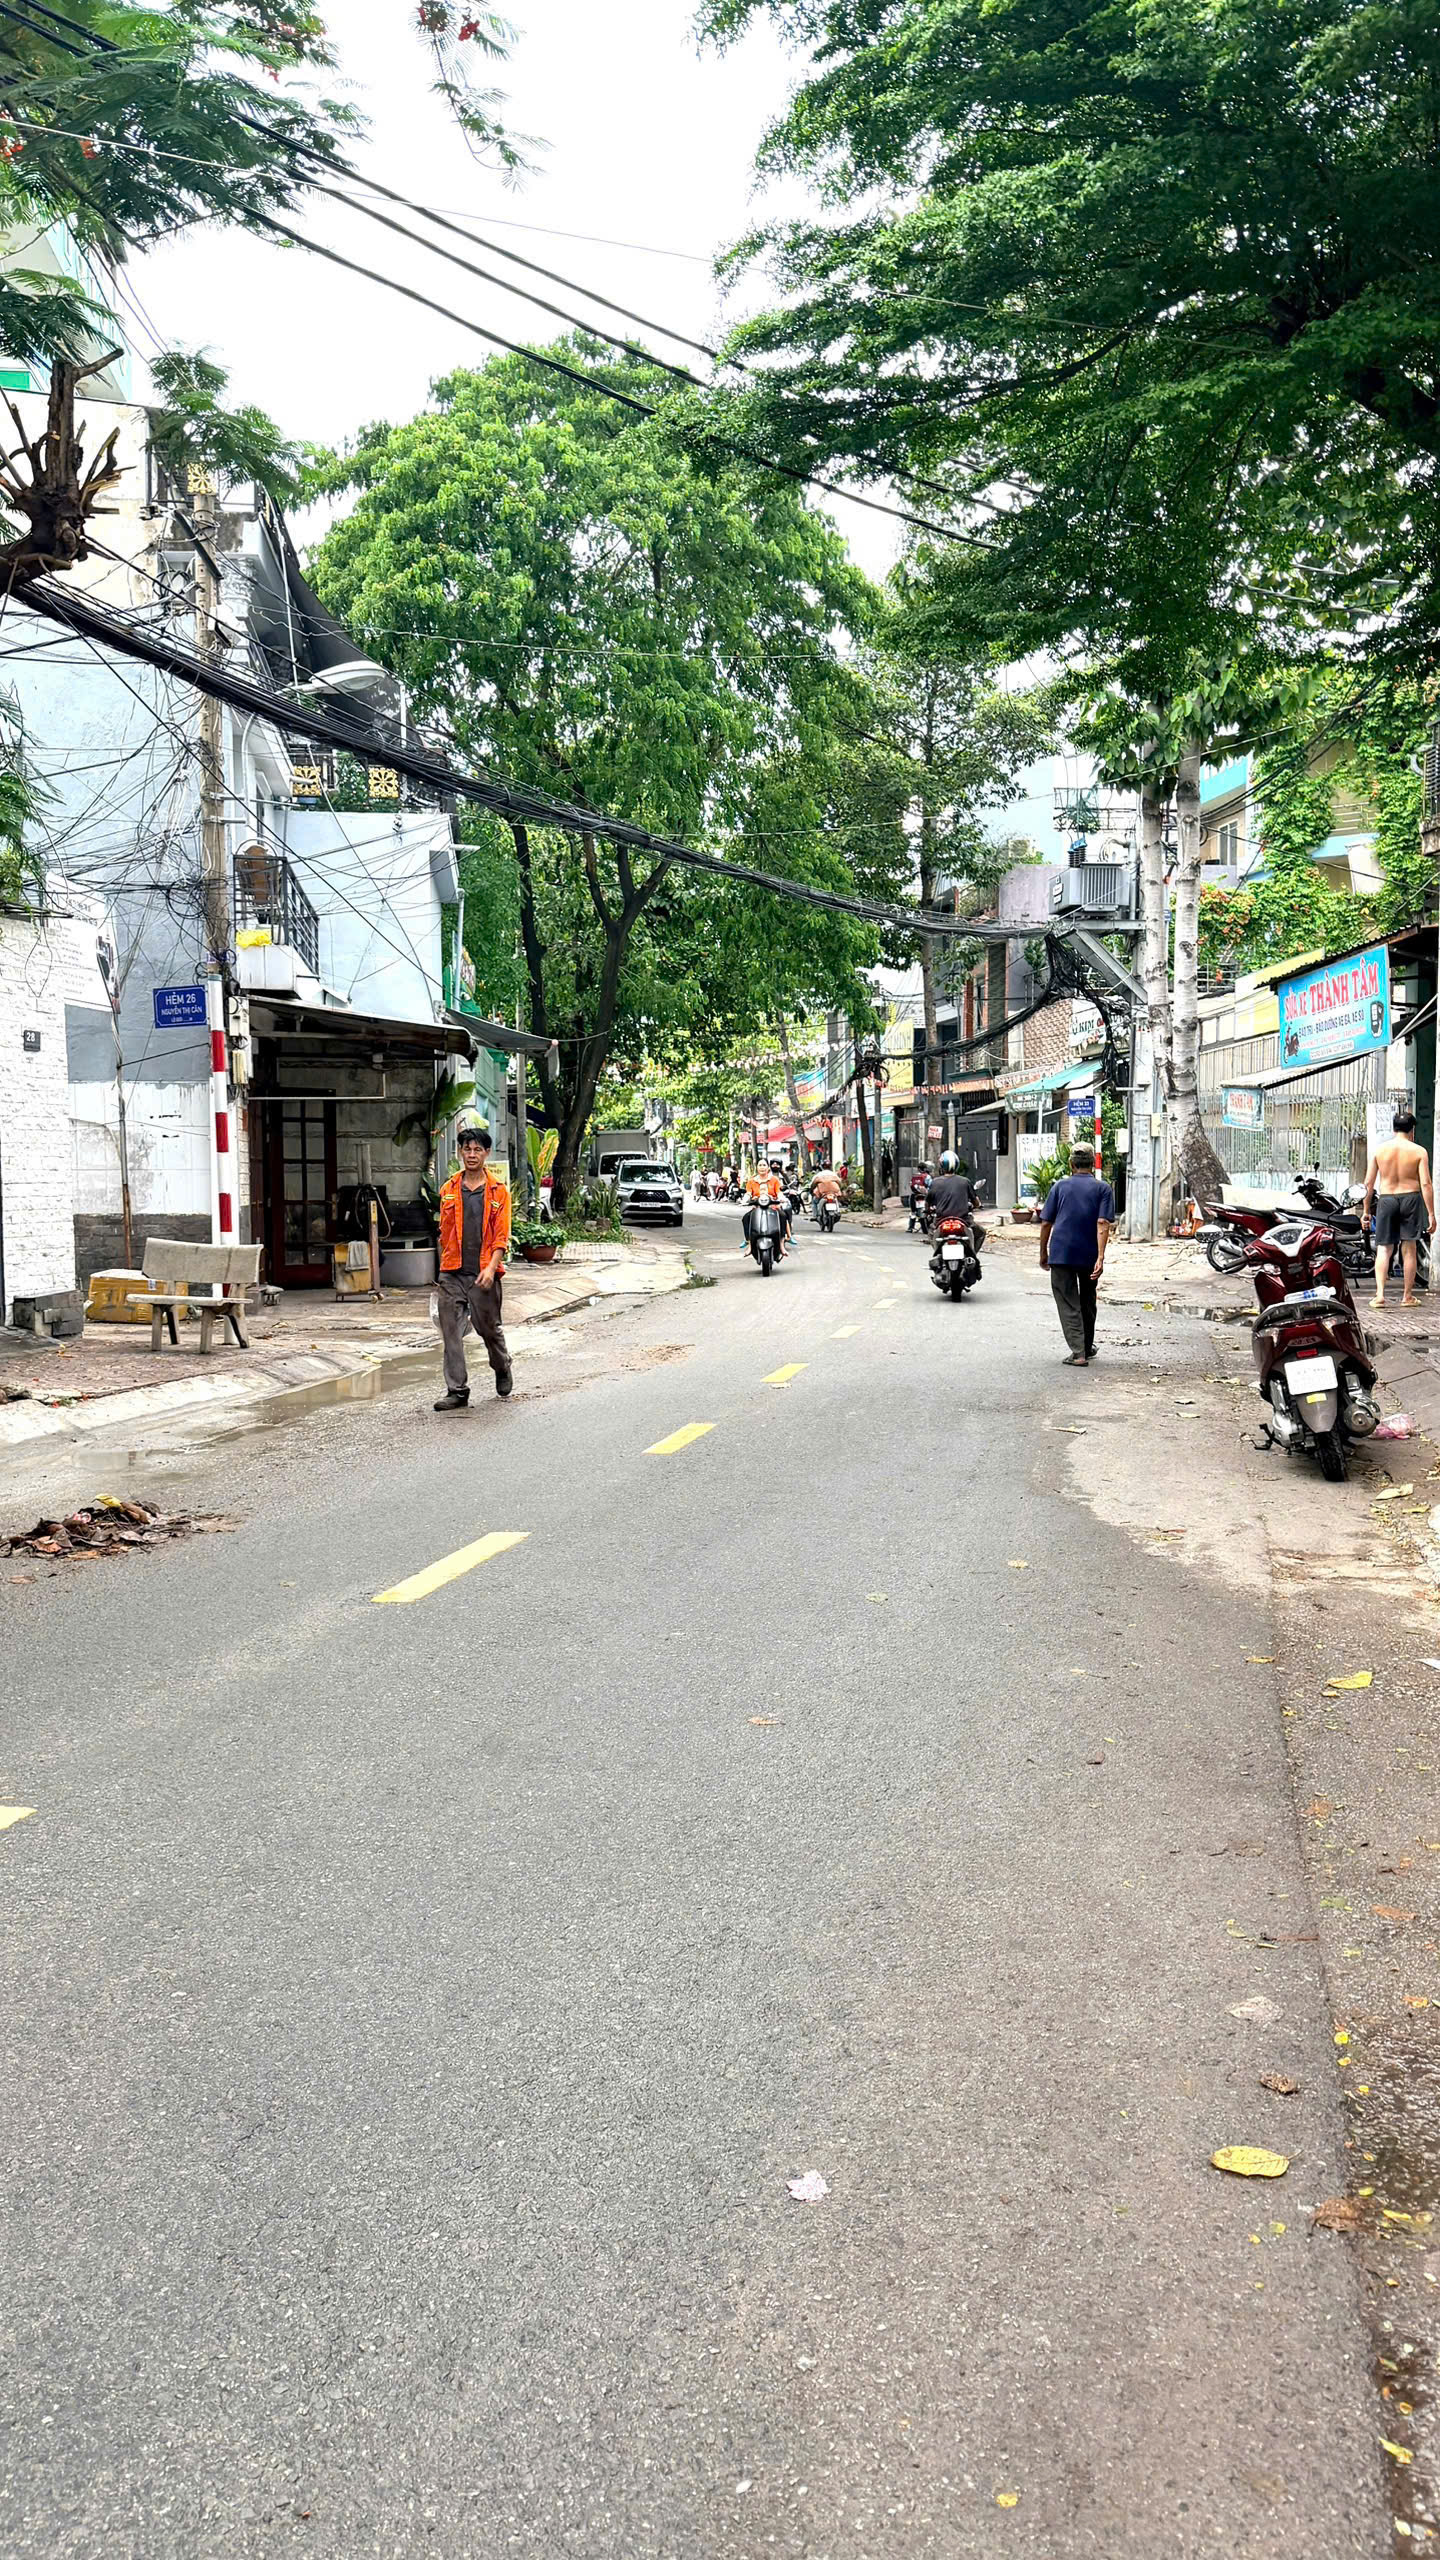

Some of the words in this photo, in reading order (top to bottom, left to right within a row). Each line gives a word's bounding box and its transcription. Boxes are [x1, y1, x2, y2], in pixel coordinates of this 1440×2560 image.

[1309, 970, 1349, 1014] THÀNH
[1351, 956, 1379, 1001] TÂM
[165, 991, 185, 1005] HẺM
[185, 993, 197, 1004] 26
[26, 1031, 36, 1042] 28
